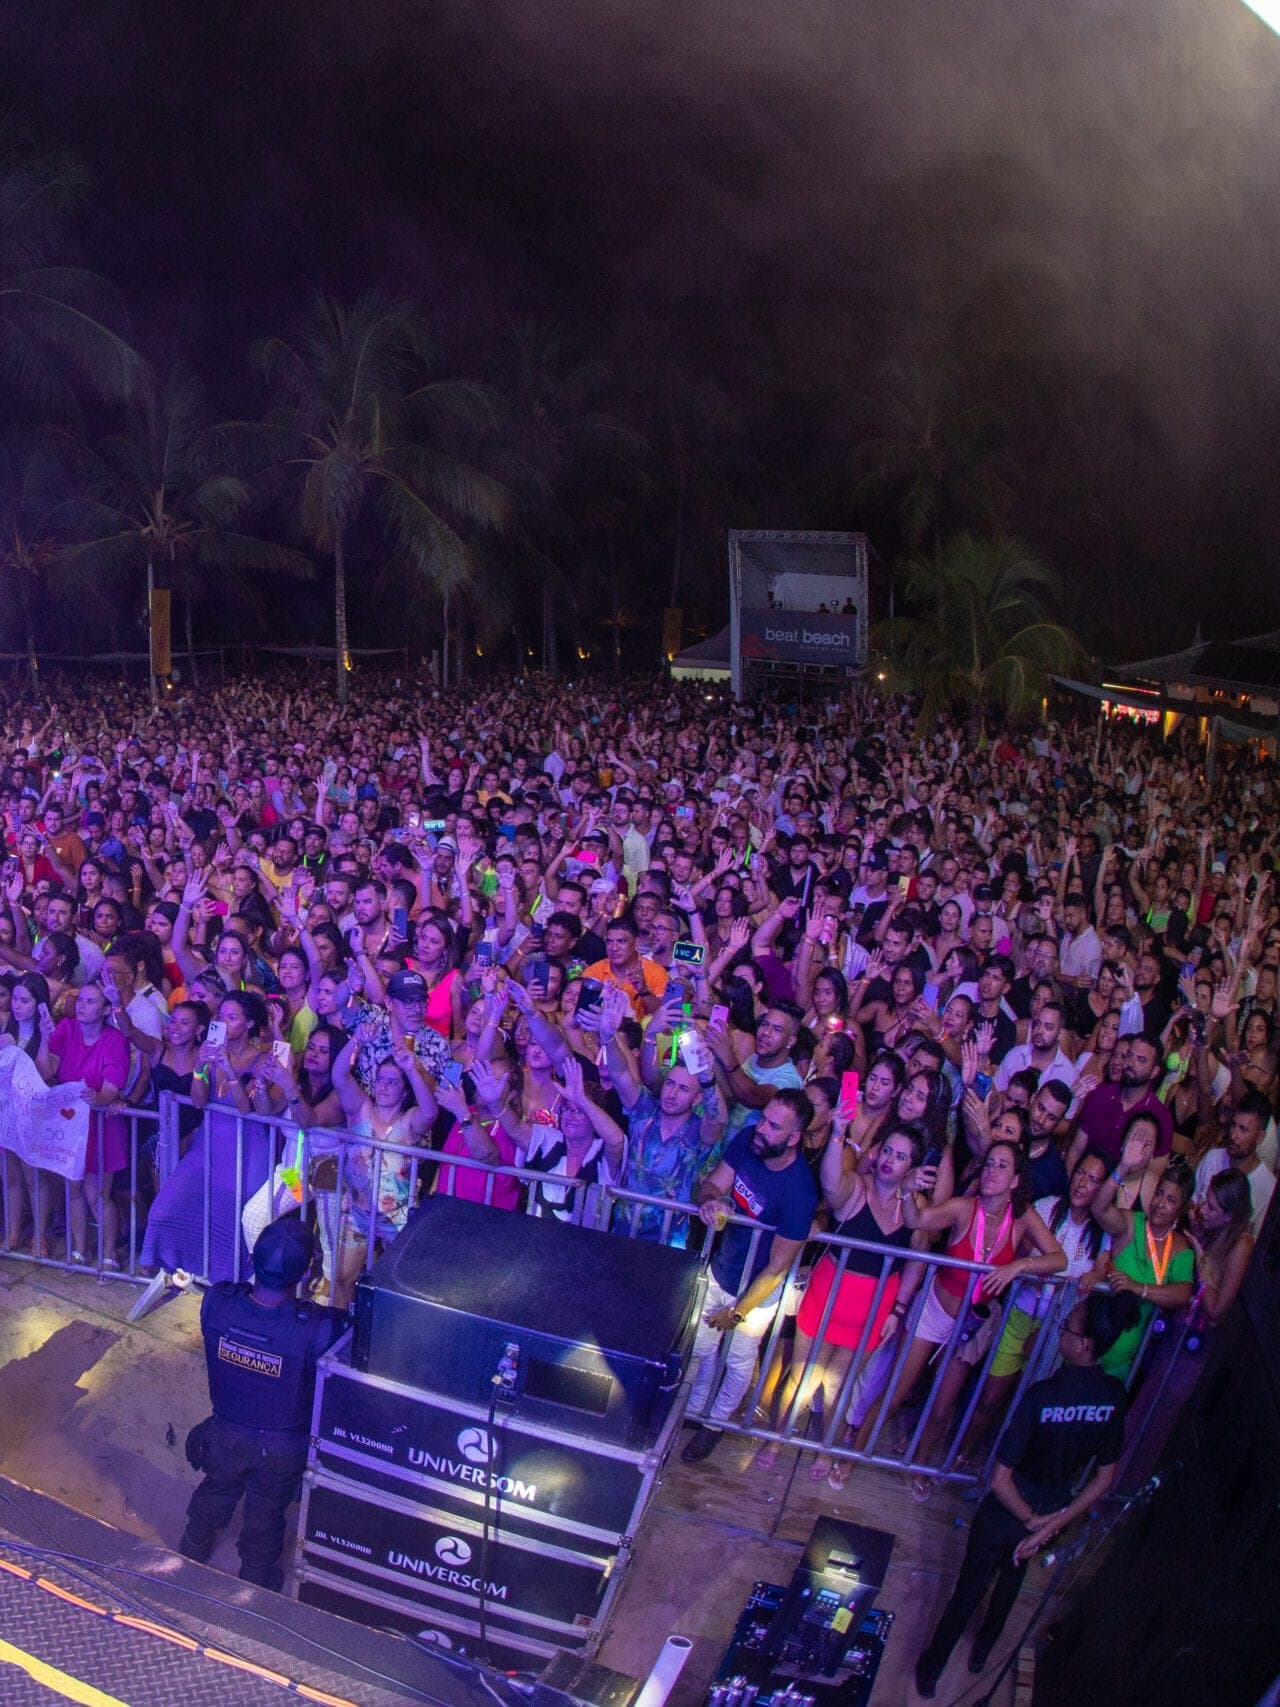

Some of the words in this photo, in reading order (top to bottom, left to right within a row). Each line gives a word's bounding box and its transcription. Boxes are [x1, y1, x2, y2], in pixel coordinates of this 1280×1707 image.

[765, 627, 799, 642] beat
[803, 629, 850, 646] beach
[1041, 1405, 1115, 1423] PROTECT
[408, 1447, 538, 1501] UNIVERSOM
[388, 1550, 508, 1600] UNIVERSOM
